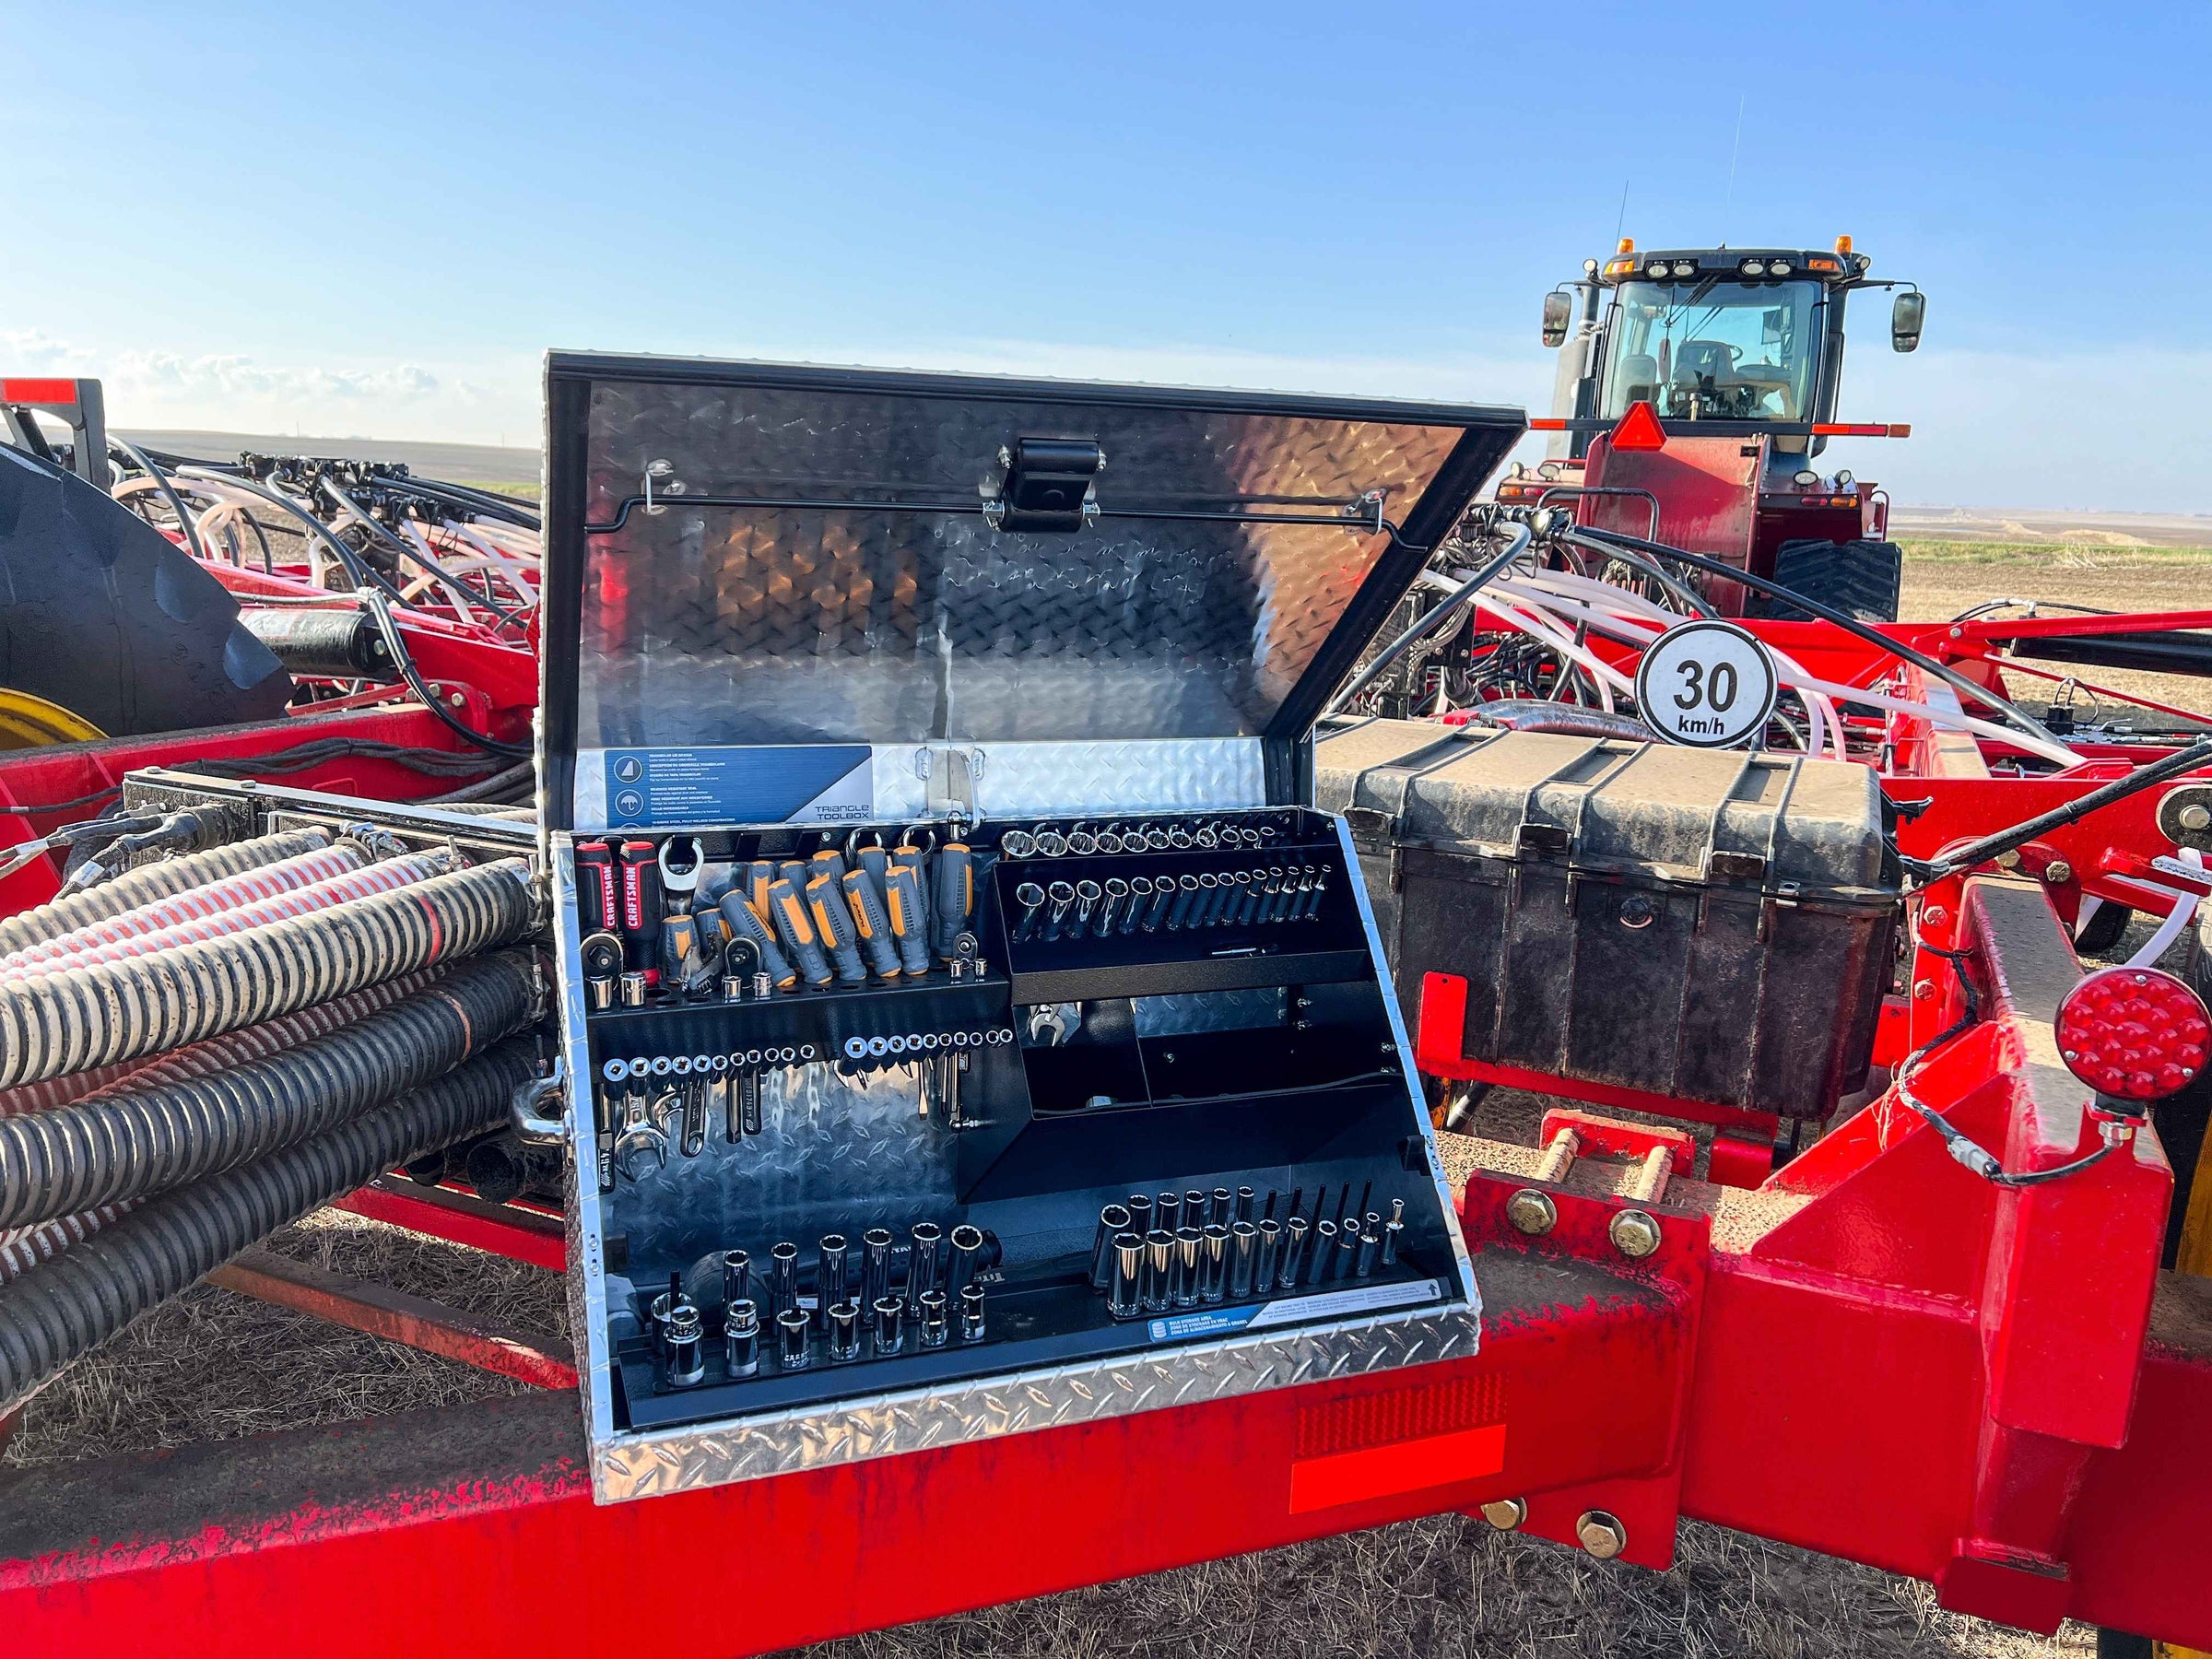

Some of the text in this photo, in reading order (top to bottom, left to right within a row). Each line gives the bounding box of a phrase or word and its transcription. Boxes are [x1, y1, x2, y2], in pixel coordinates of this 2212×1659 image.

[1674, 659, 1737, 712] 30
[1677, 714, 1724, 735] km/h
[817, 812, 869, 820] TOOLBOX
[603, 865, 616, 927] CRAFTSMAN
[626, 866, 638, 927] CRAFTSMAN
